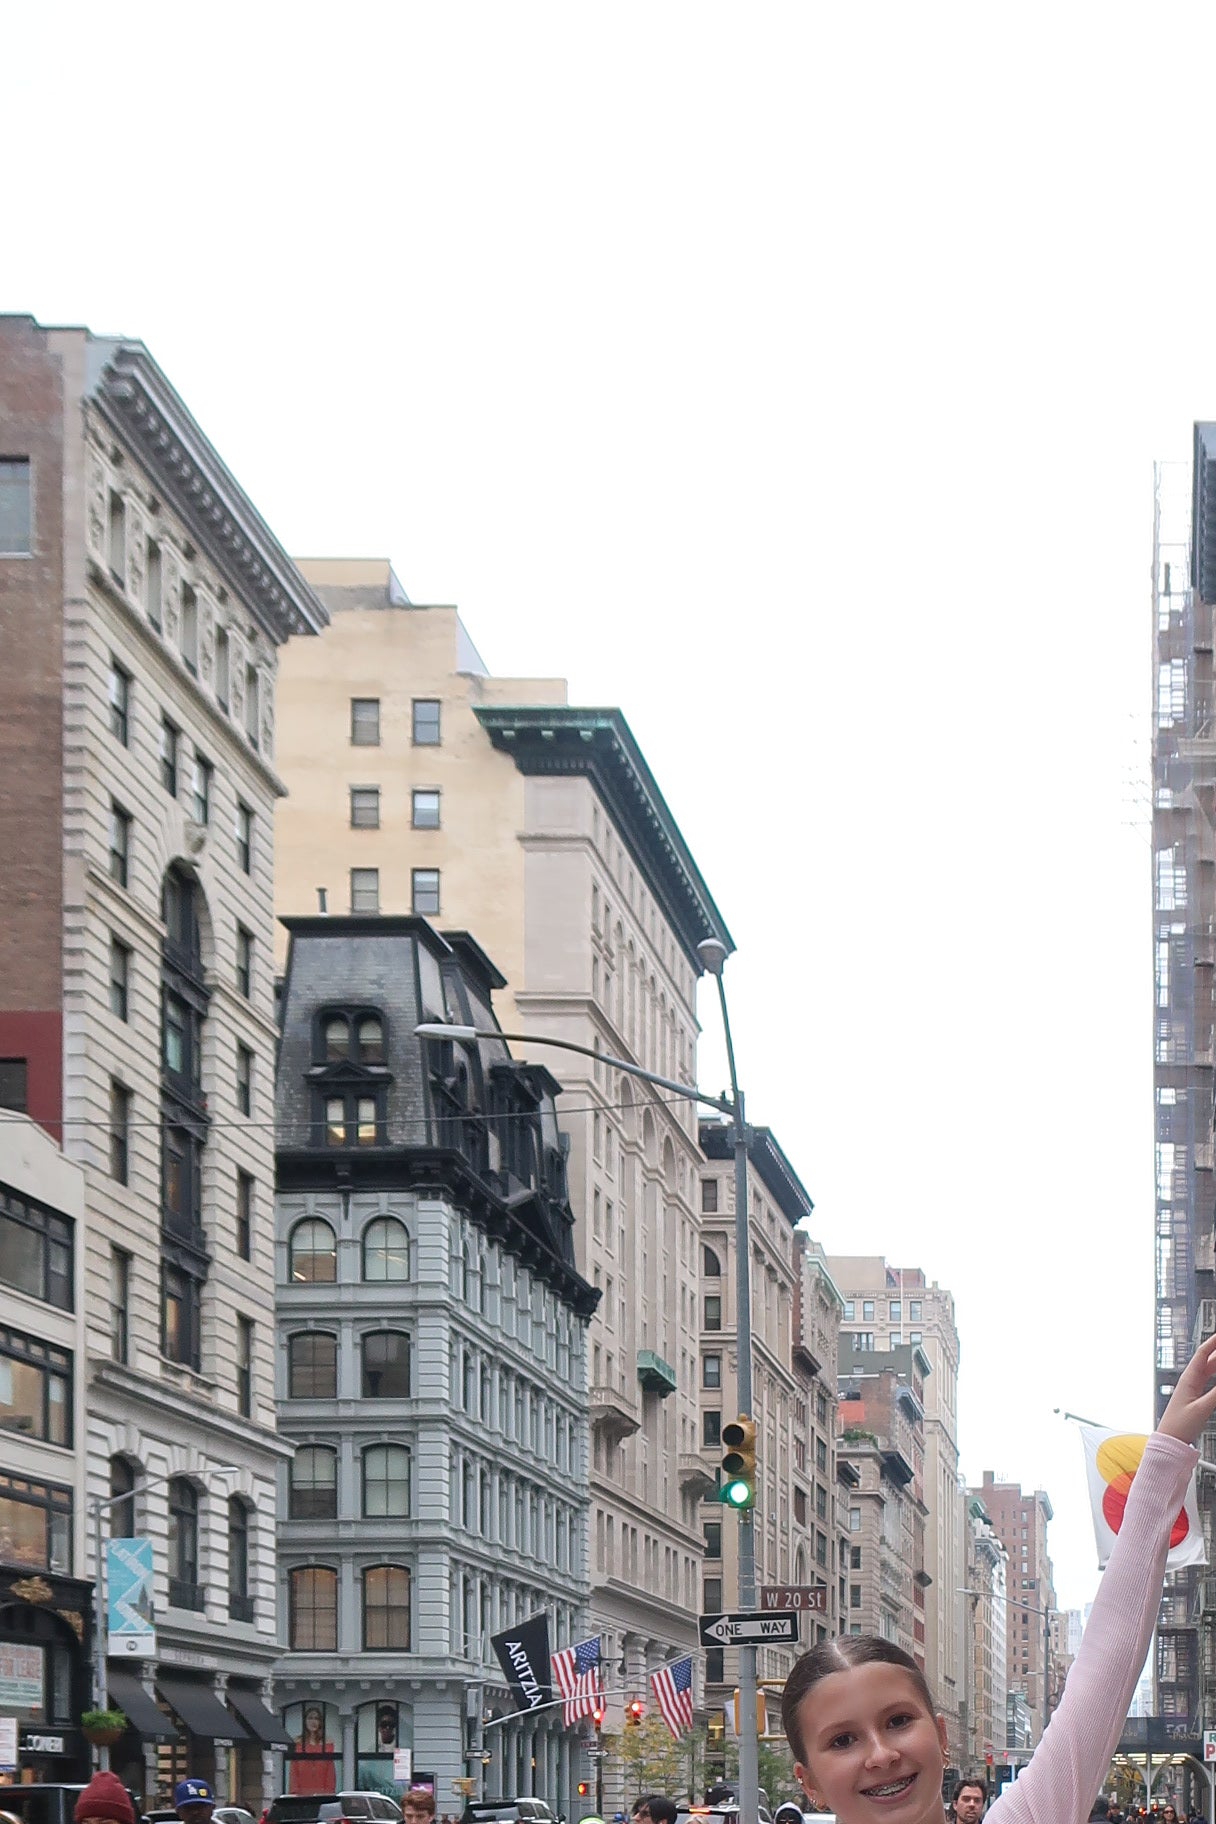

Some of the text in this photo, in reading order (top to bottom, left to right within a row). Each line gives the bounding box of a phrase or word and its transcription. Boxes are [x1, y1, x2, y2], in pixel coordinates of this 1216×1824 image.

[766, 1592, 822, 1608] W 20 St
[715, 1621, 787, 1637] ONE WAY
[504, 1641, 542, 1707] ARITZIA
